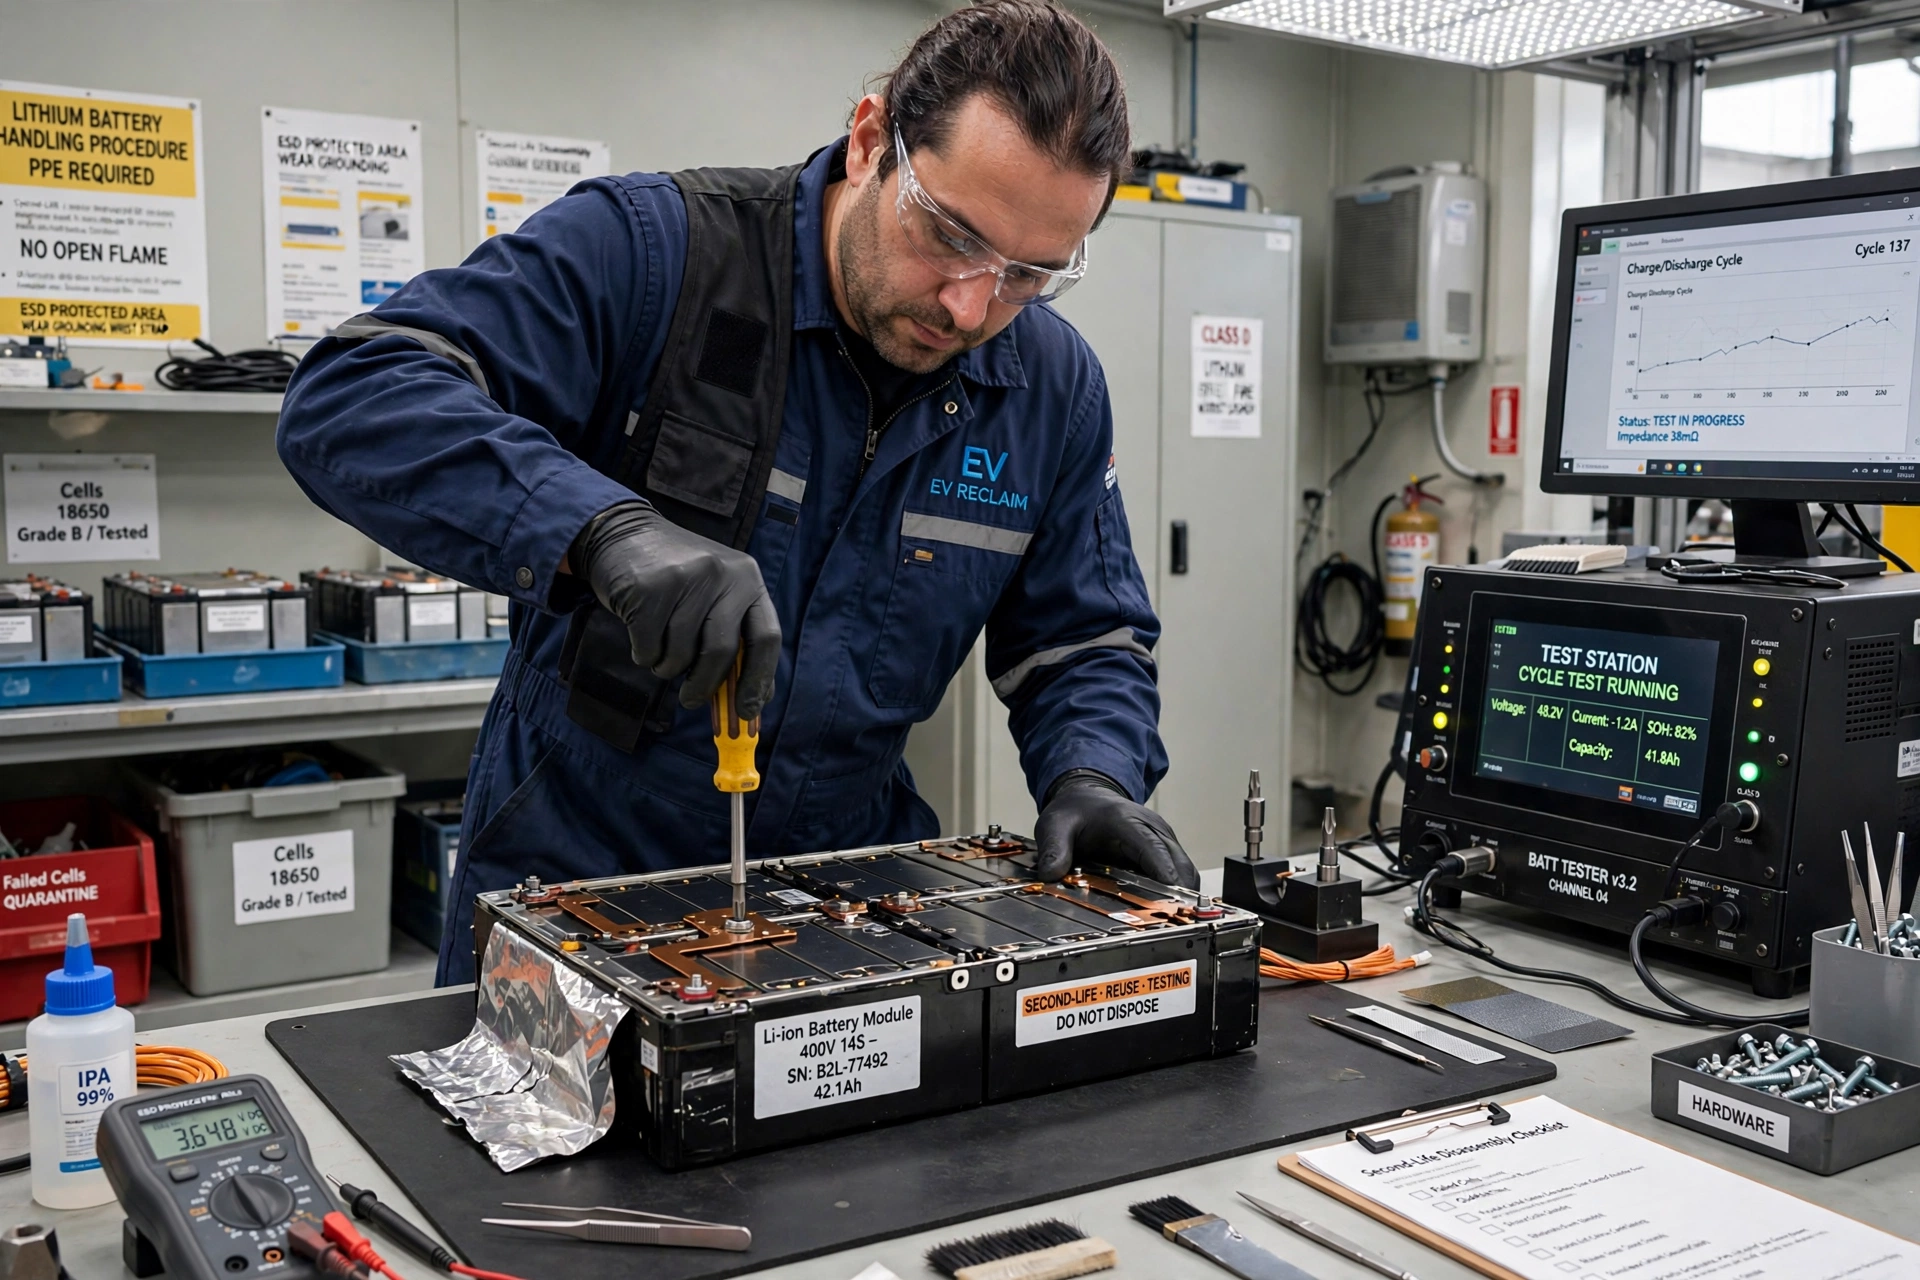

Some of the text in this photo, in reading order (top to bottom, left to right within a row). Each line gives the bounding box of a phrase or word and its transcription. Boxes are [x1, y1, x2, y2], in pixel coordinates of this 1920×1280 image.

[13, 101, 163, 133] LITHIUM BATTERY
[90, 135, 188, 161] PROCEDURE
[277, 135, 408, 158] ESD PROTECTED AREA
[29, 157, 155, 186] PPE REQUIRED
[278, 153, 389, 174] WEAR GROUNDING
[20, 239, 168, 265] NO OPEN FLAME
[1855, 239, 1911, 258] Cycle 137
[1627, 252, 1743, 276] Charge/Discharge Cycle
[20, 302, 166, 321] ESD PROTECTED AREA
[22, 320, 48, 332] WEAR
[53, 321, 106, 333] GROUNDING
[1202, 325, 1239, 345] CLASS
[1618, 414, 1745, 427] Status: TEST IN PROGRESS
[1617, 431, 1699, 444] Impedance 38mΩ
[962, 445, 1009, 483] EV
[60, 482, 103, 499] Cells
[930, 478, 1028, 511] EV RECLAIM
[57, 503, 110, 520] 18650
[17, 523, 148, 542] Grade B / Tested
[1541, 643, 1659, 675] TEST STATION
[1518, 665, 1679, 702] CYCLE TEST RUNNING
[1491, 697, 1527, 716] Voltage:
[1536, 703, 1564, 720] 48.2V
[1572, 709, 1609, 728] Current:
[1647, 719, 1673, 737] SOH:
[1674, 724, 1697, 741] 82%
[1568, 737, 1680, 767] Capacity: 41.8Ah
[274, 842, 314, 862] Cells
[3, 867, 87, 890] Failed Cells
[270, 866, 319, 886] 18650
[1528, 851, 1637, 892] BATT TESTER v3.2
[3, 885, 99, 911] QUARANTINE
[241, 894, 281, 912] Grade
[285, 893, 294, 907] B
[307, 885, 347, 904] Tested
[1549, 878, 1609, 904] CHANNEL 04
[1024, 986, 1098, 1014] SECOND-LIFE
[1105, 979, 1140, 1000] REUSE
[1147, 970, 1190, 992] TESTING
[763, 1004, 914, 1045] Li-ion Battery Module
[1056, 997, 1159, 1031] DO NOT DISPOSE
[799, 1038, 837, 1059] 400V
[840, 1033, 865, 1053] 14S
[78, 1067, 111, 1088] IPA
[787, 1051, 889, 1085] SN: B2L-77492
[77, 1086, 114, 1107] 99%
[813, 1078, 862, 1100] 42.1Ah
[1691, 1094, 1775, 1138] HARDWARE
[173, 1117, 238, 1152] 3.648
[1361, 1120, 1569, 1178] Second-Life Disassembly Checklist
